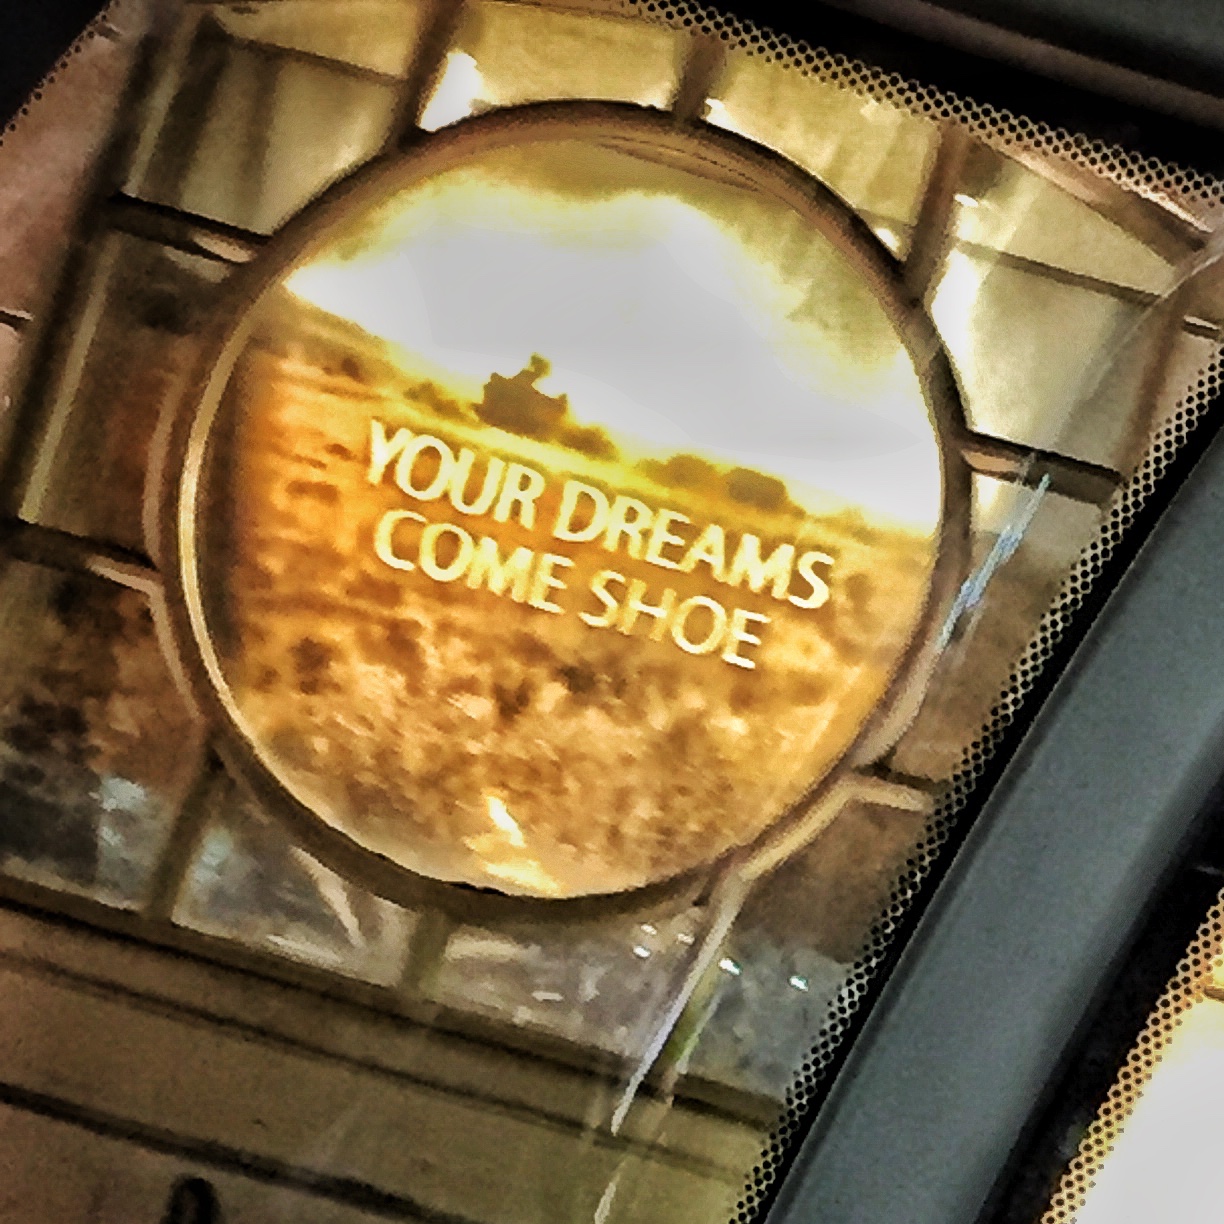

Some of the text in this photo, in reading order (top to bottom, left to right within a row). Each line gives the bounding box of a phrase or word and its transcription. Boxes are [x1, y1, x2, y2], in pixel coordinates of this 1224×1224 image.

[368, 418, 836, 609] YOUR DREAMS
[373, 509, 772, 669] COME SHOE
